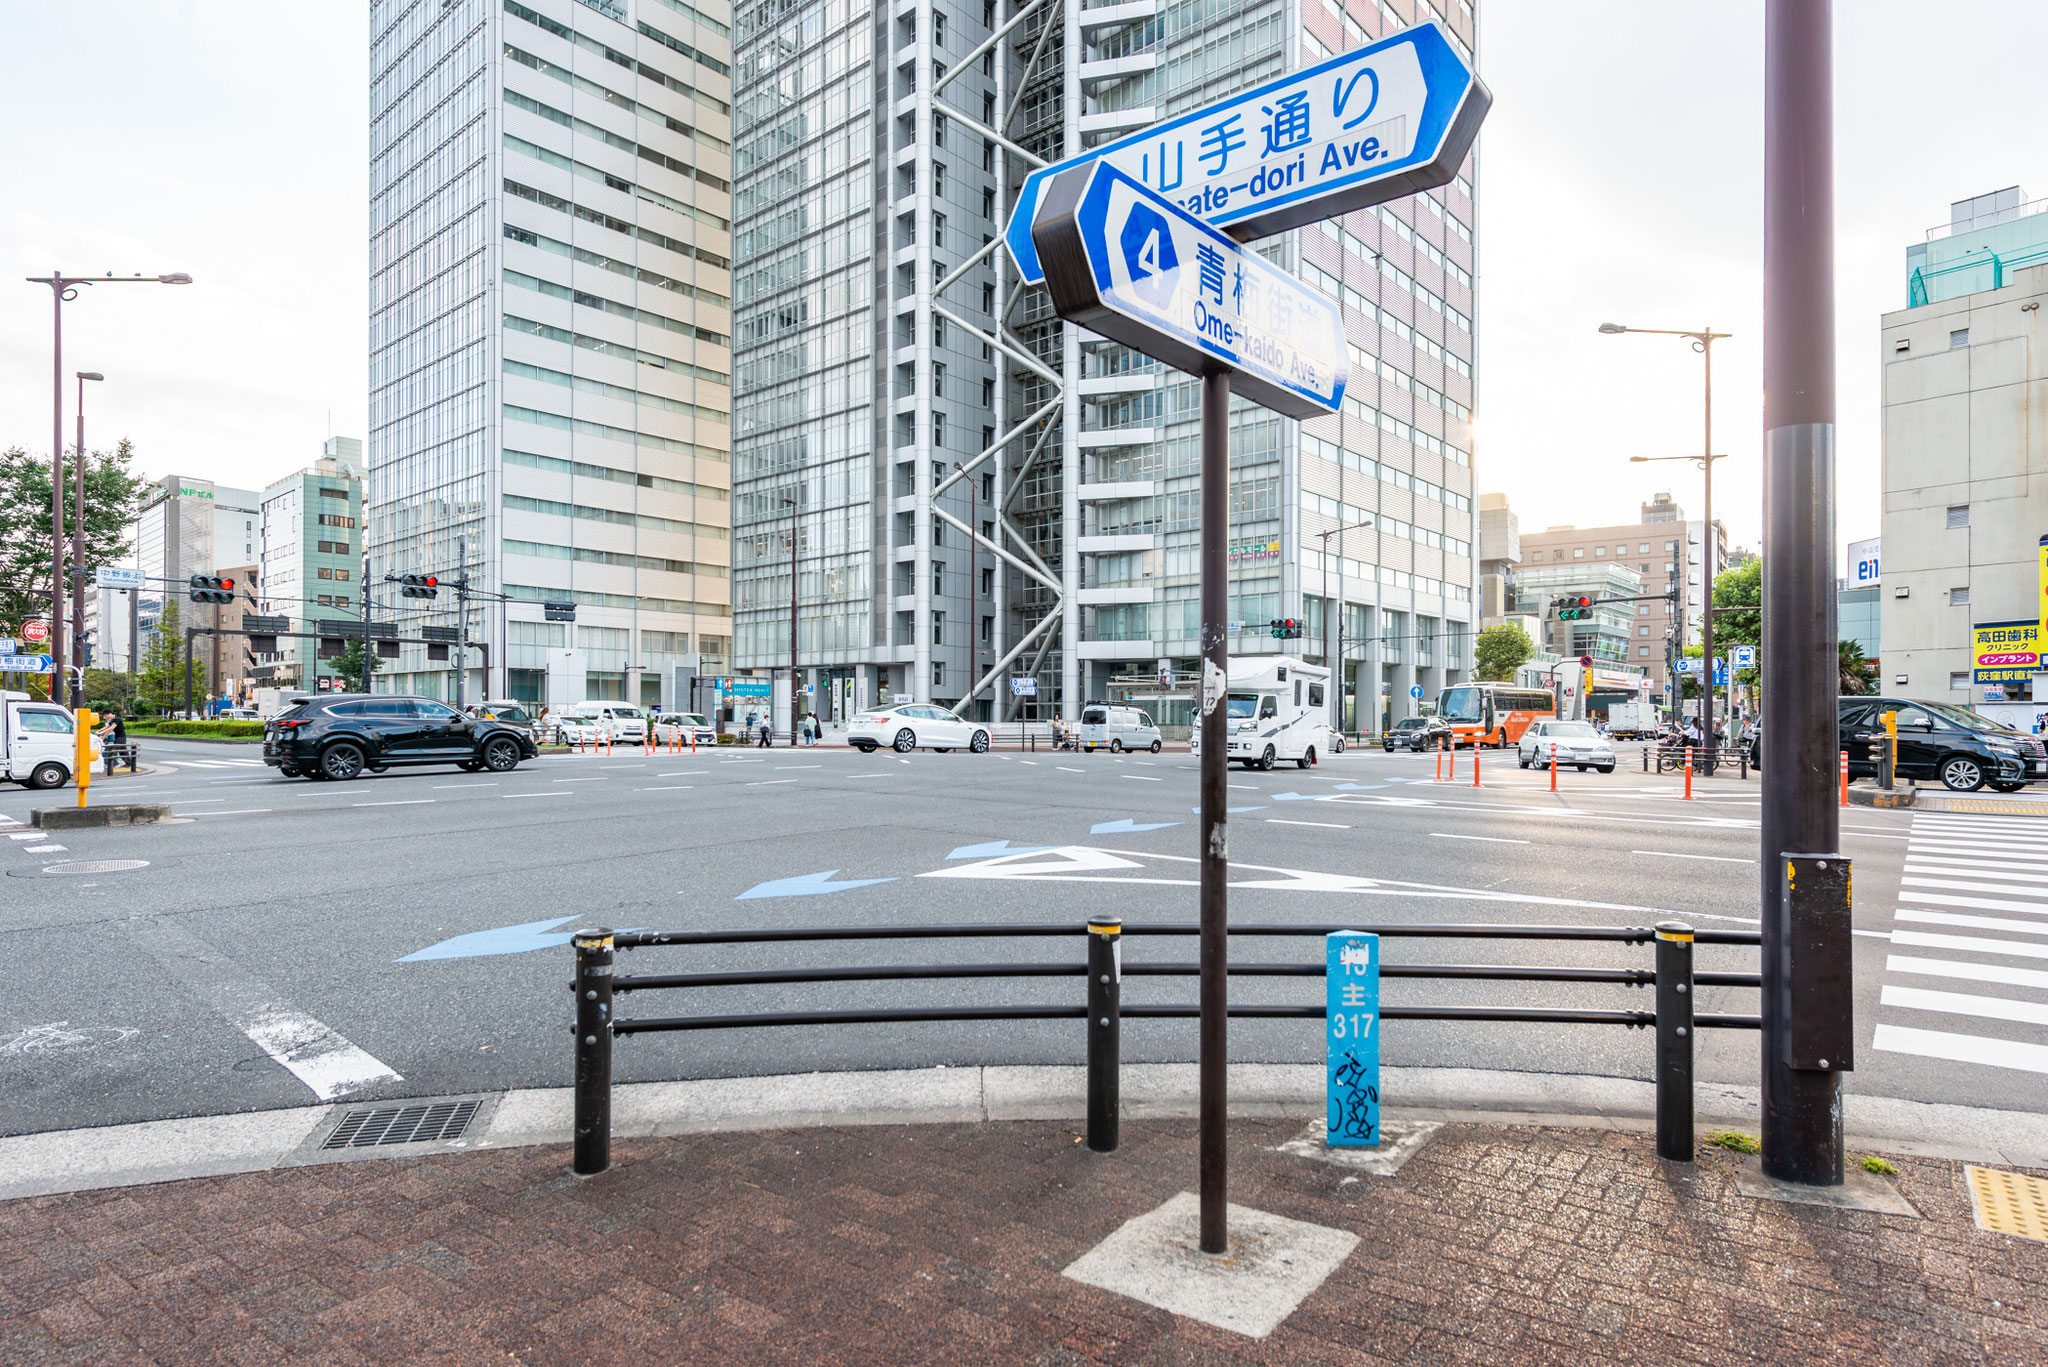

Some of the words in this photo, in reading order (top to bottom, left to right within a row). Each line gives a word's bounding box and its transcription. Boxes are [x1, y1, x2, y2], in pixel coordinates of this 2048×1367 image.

[1142, 67, 1380, 192] 山手通り
[1178, 152, 1305, 215] ate-dori
[1319, 136, 1388, 176] Ave.
[1136, 227, 1166, 290] 4
[1196, 242, 1322, 358] 青梅街道
[1193, 300, 1284, 369] Ome-kaido
[1290, 351, 1319, 389] Ave.
[1977, 628, 2038, 643] 高田歯科
[1986, 643, 2029, 652] クリニック
[0, 658, 36, 666] 梅街道
[1981, 654, 2033, 664] インプラント
[1333, 1013, 1374, 1039] 317
